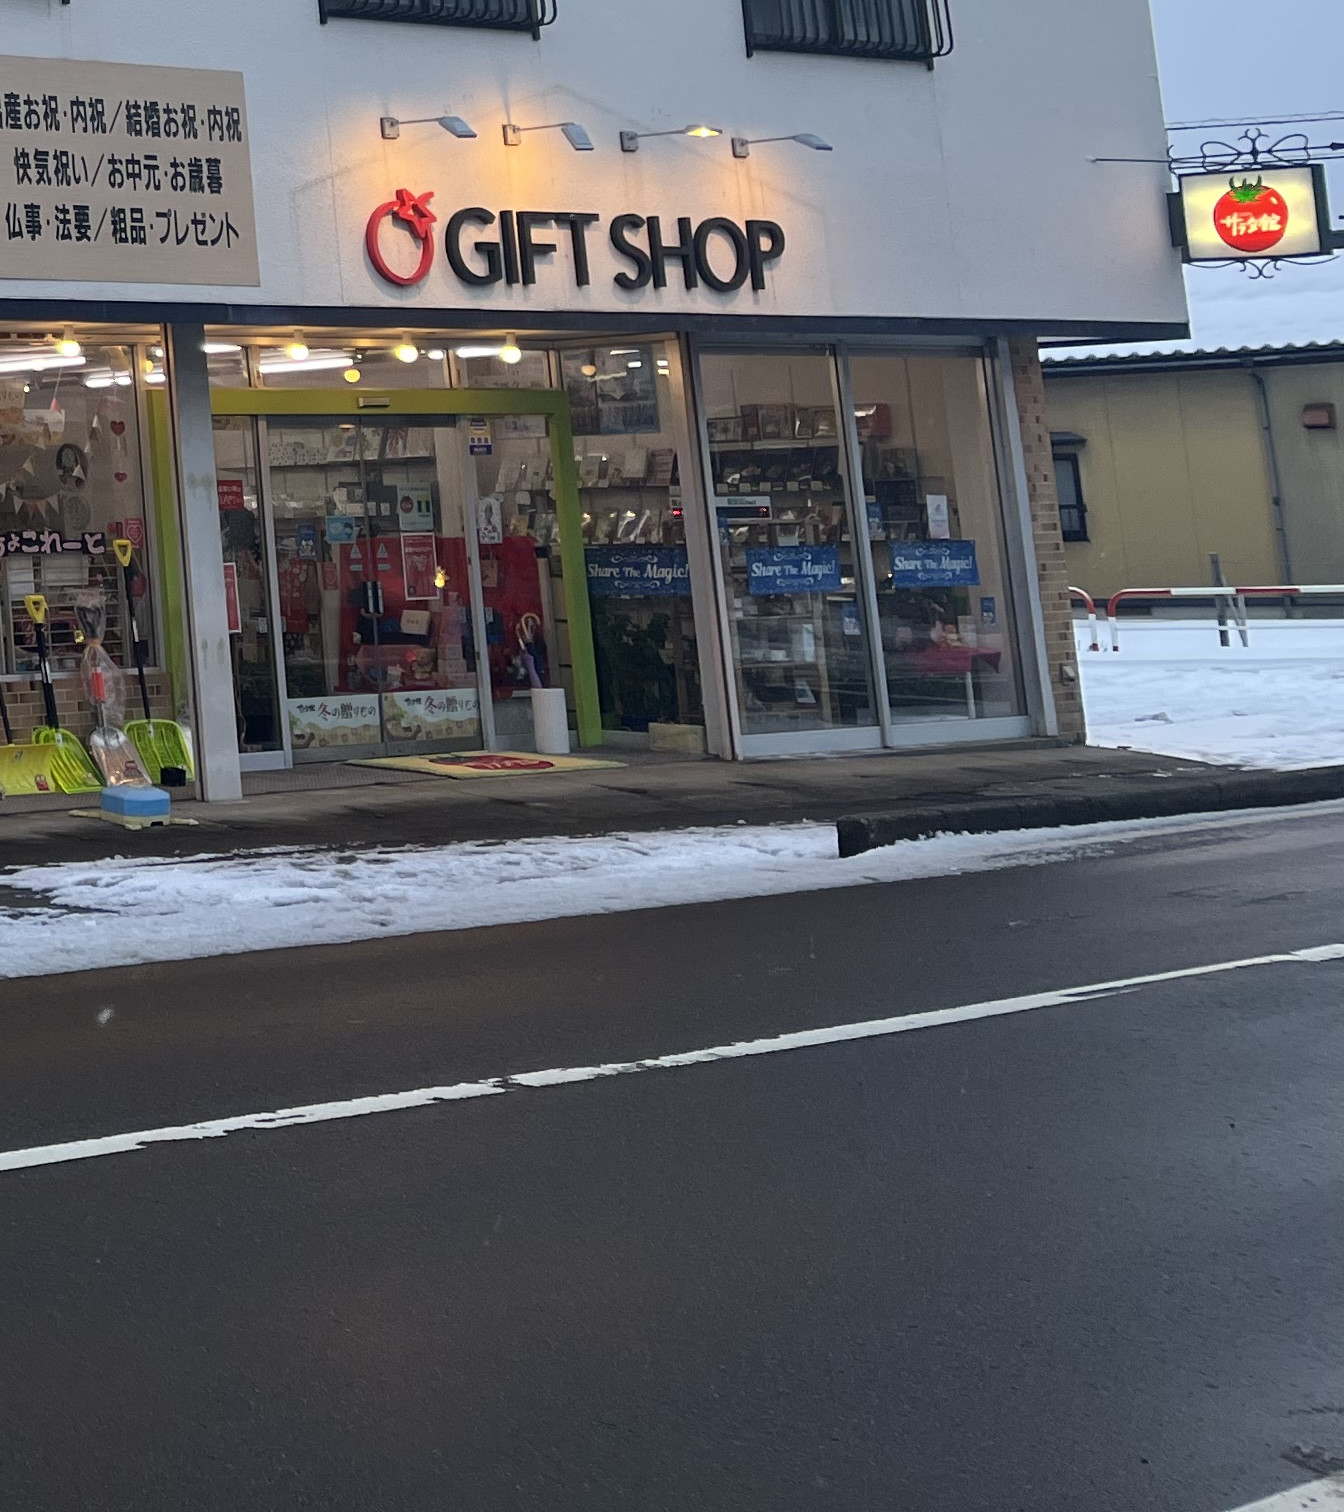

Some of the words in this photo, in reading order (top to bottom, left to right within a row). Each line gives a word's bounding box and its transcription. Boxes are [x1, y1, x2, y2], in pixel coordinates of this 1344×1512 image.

[445, 206, 600, 290] GIFT
[610, 212, 785, 291] SHOP
[588, 564, 620, 578] Share
[623, 566, 640, 577] The
[643, 563, 689, 583] Magic!
[751, 563, 781, 577] Share
[784, 565, 800, 576] The
[802, 560, 835, 580] Magic!
[894, 556, 922, 571] Share
[924, 559, 939, 569] The
[940, 556, 973, 575] Magic!
